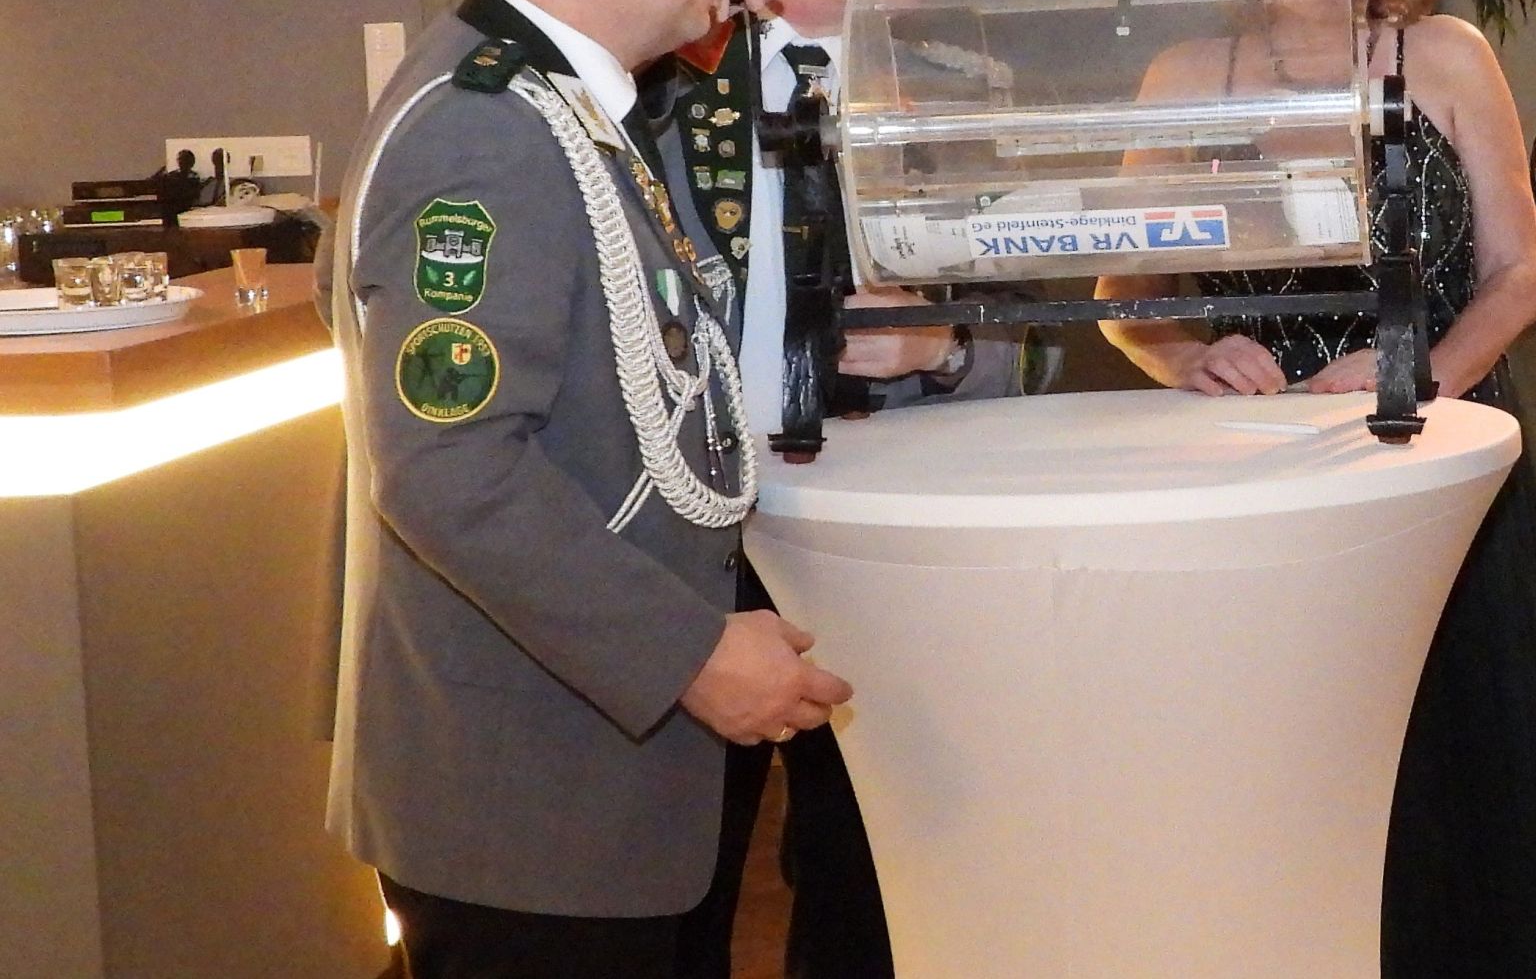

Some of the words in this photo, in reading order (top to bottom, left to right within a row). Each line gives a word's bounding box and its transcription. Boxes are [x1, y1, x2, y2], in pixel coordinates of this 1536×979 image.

[971, 222, 994, 233] eG
[998, 214, 1136, 231] Dinklage-Steinfeld
[976, 234, 1078, 256] BANK
[1090, 231, 1139, 251] VR
[443, 271, 458, 287] 3.
[424, 288, 473, 302] Kompanie
